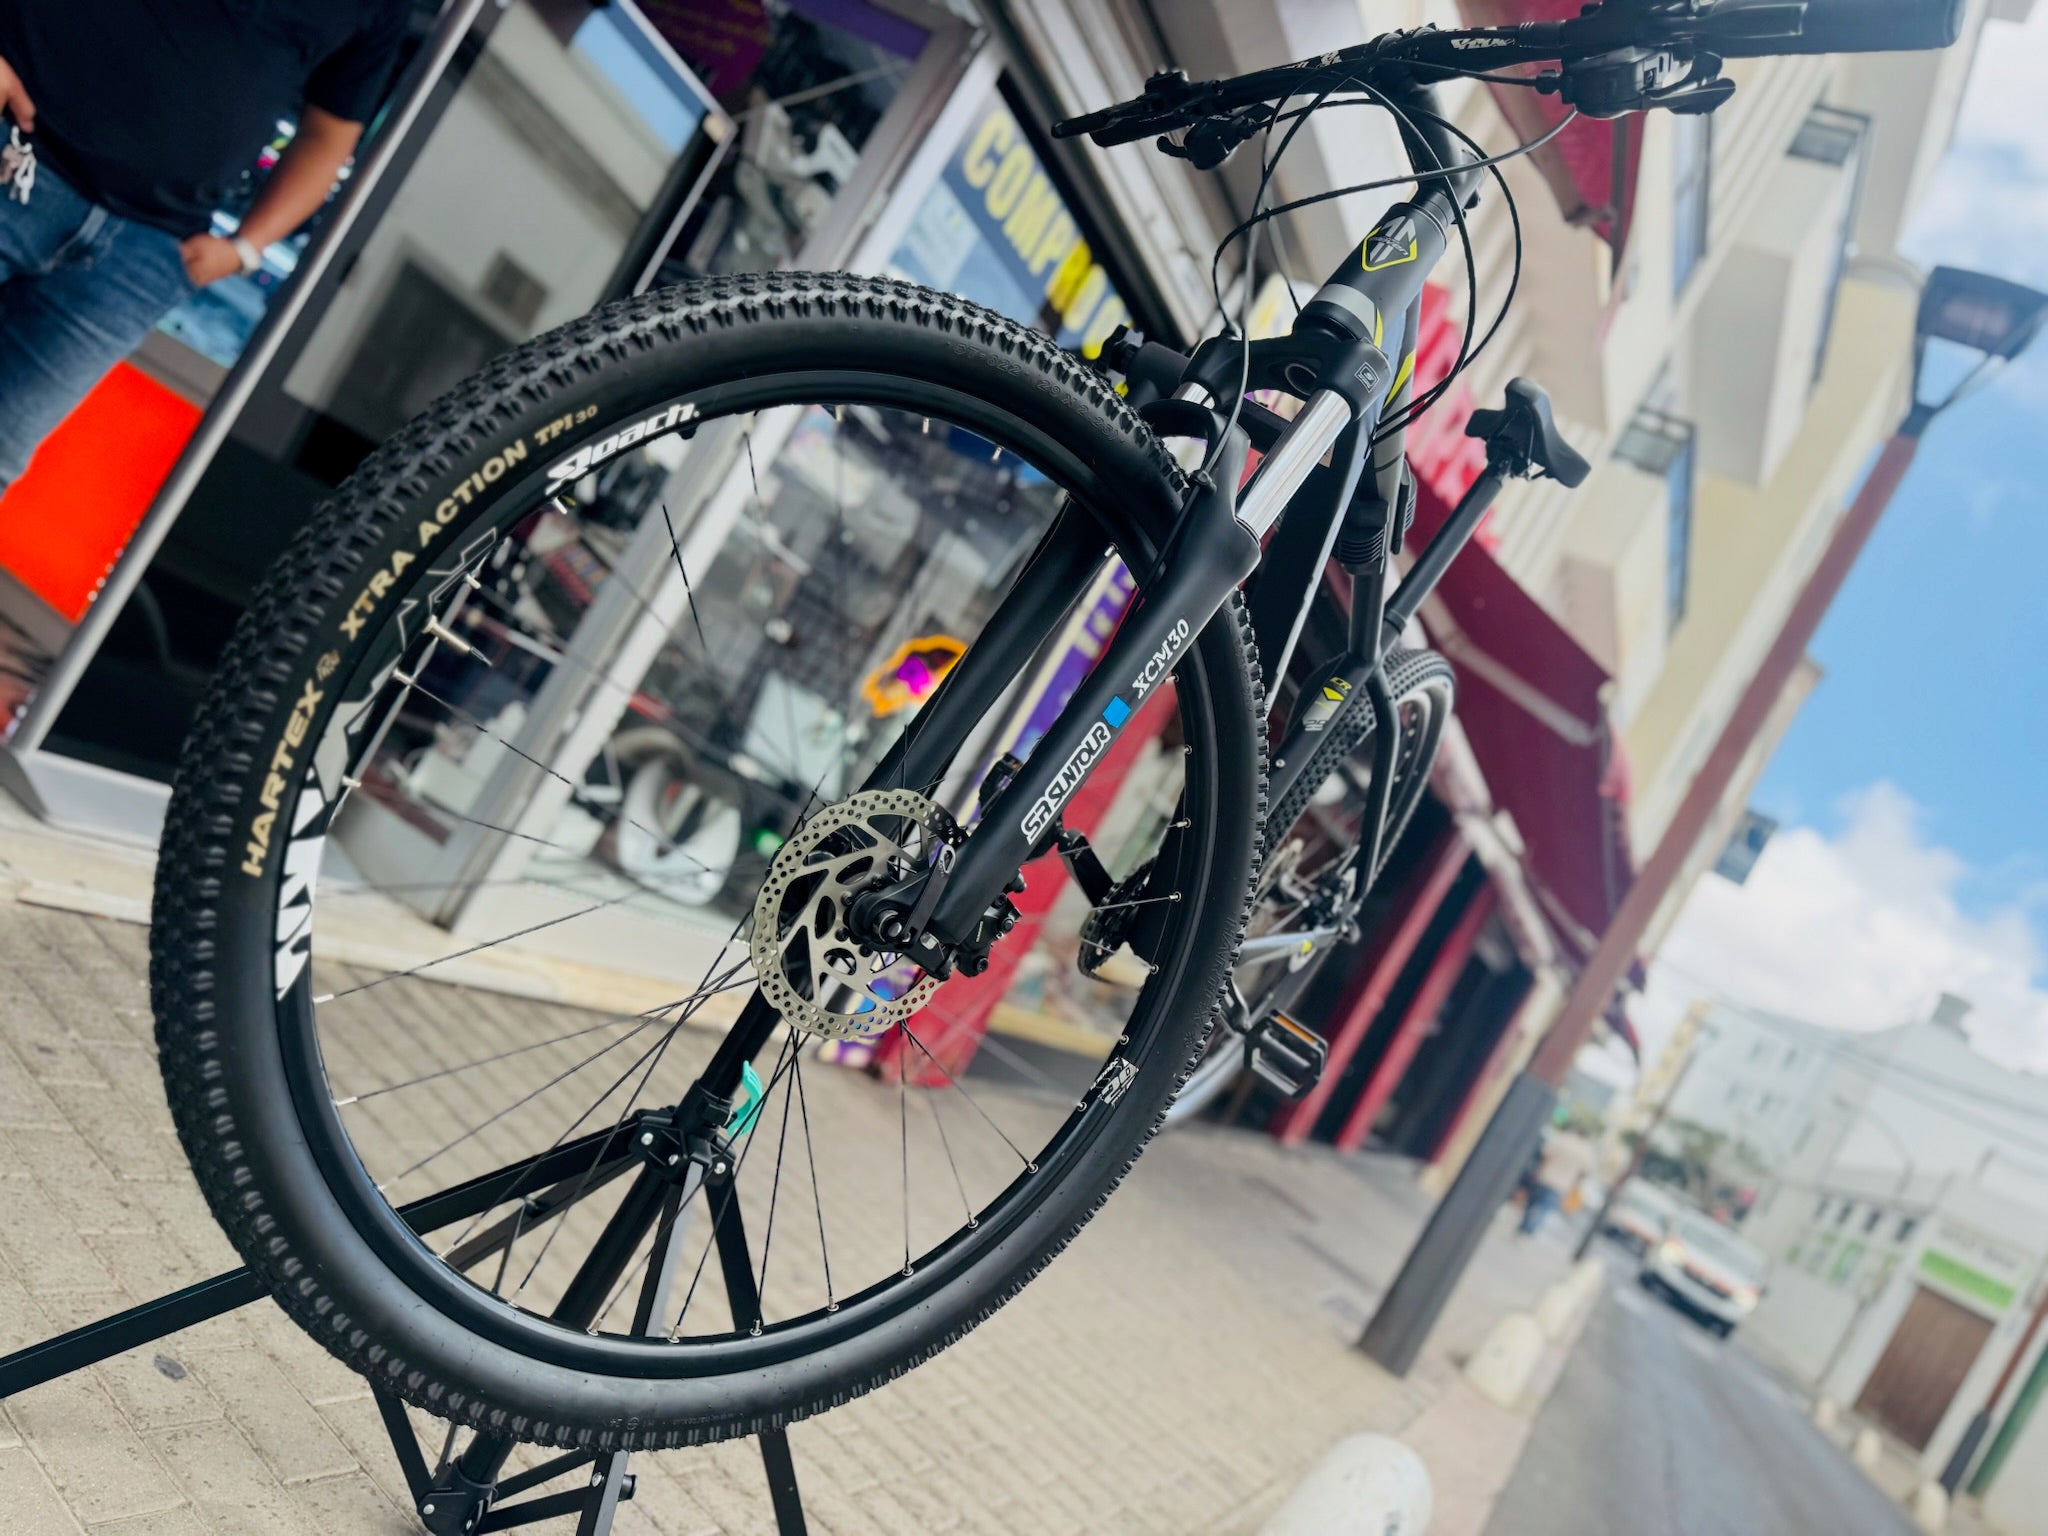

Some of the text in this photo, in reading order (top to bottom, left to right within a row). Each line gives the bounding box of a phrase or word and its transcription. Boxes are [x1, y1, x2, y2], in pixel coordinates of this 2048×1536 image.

[241, 404, 599, 878] HARTEX XTRA ACTION TPI 30
[1045, 720, 1112, 808] SUNTOUR
